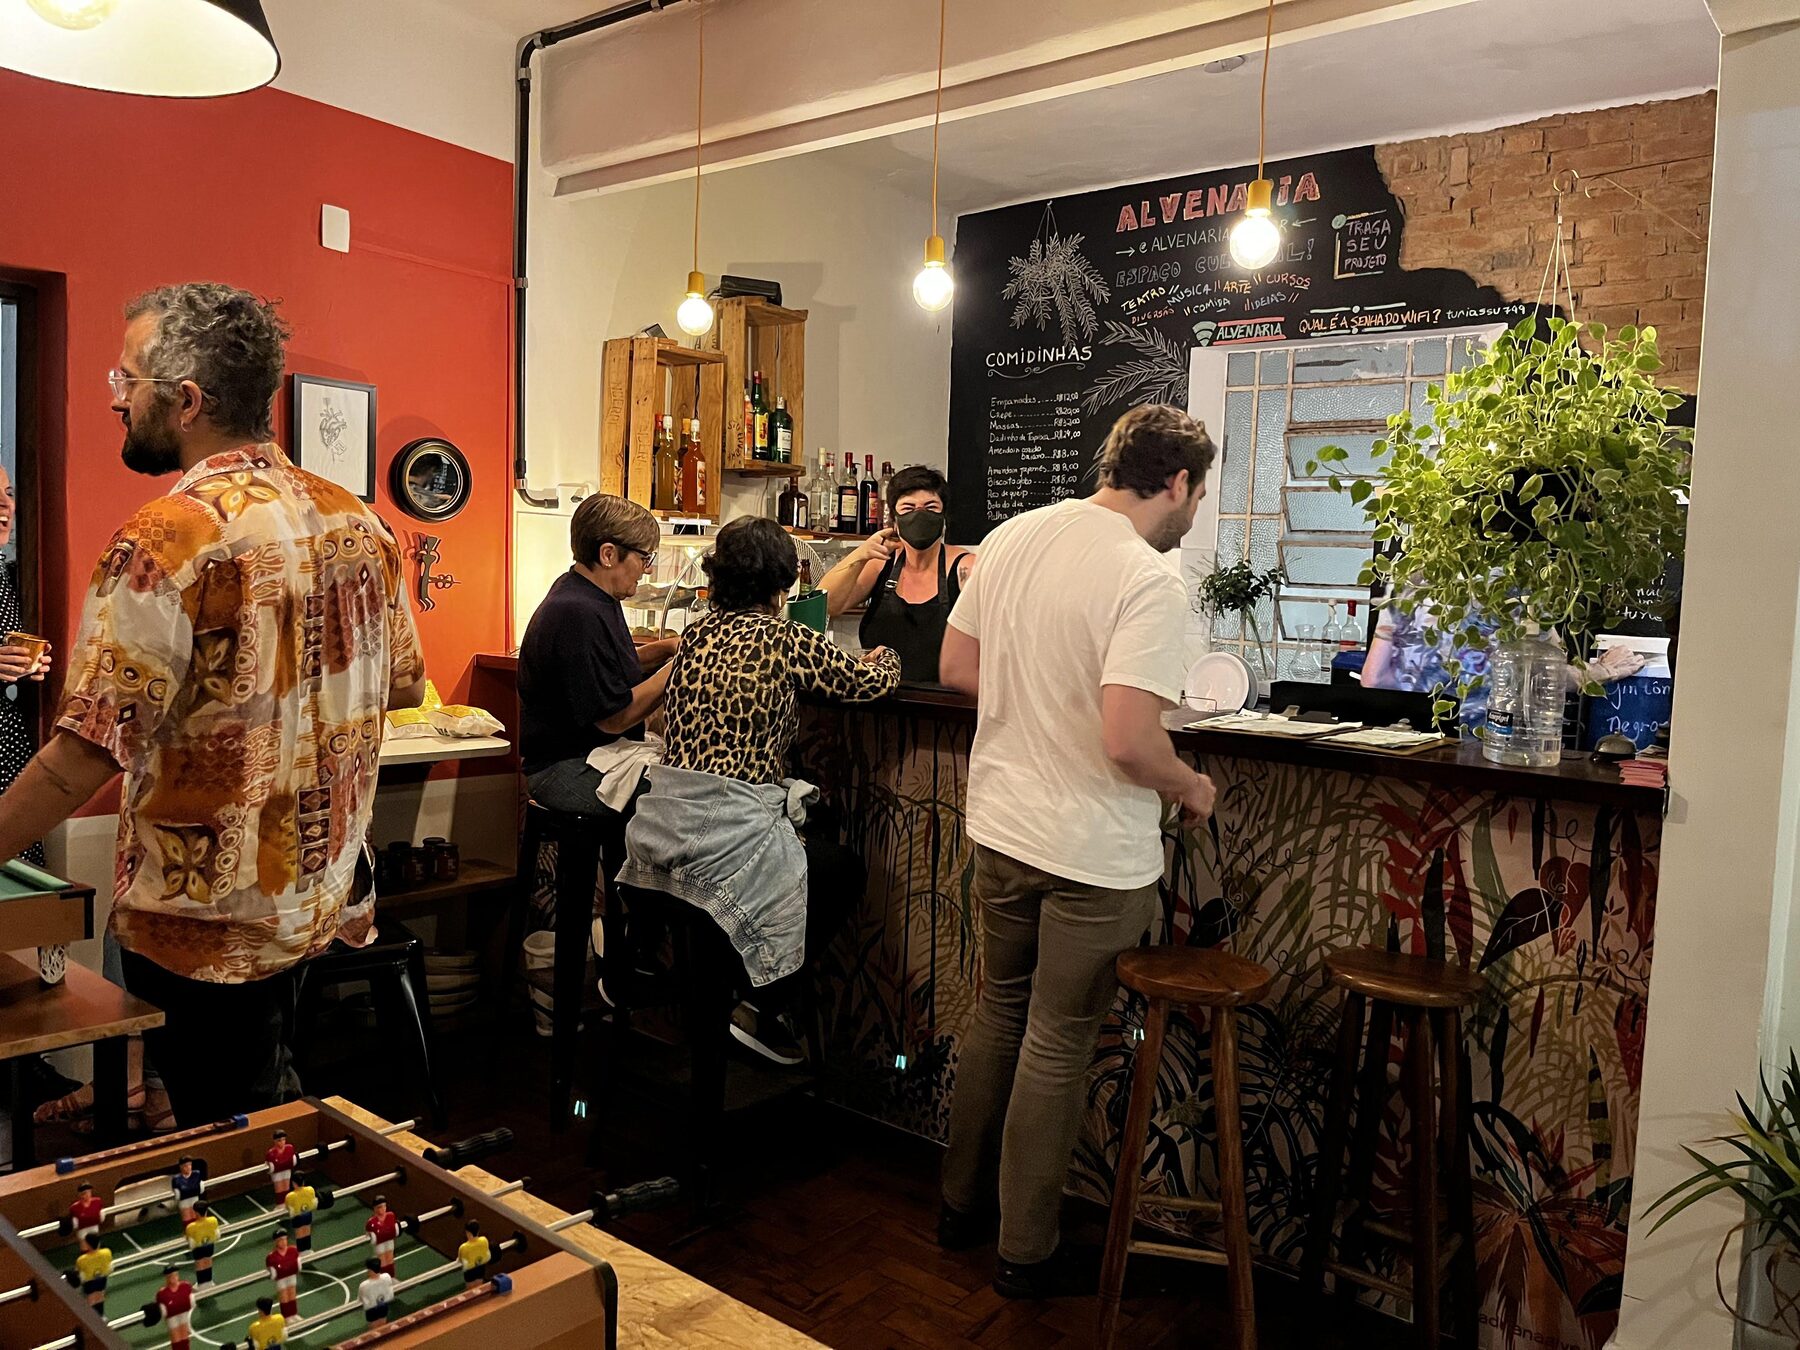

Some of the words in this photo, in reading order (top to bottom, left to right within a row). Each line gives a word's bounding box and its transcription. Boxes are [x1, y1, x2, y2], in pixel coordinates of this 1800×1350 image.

[1116, 172, 1320, 232] ALVENAIA
[1347, 219, 1391, 236] TRAGA
[1346, 236, 1387, 252] SEU
[1344, 253, 1387, 270] PROJETO
[1120, 287, 1166, 311] TEATRO
[1223, 281, 1252, 294] ARTE
[1266, 273, 1311, 287] CURSOS
[1217, 322, 1282, 339] ALVENARIA
[1299, 319, 1327, 334] QUAL
